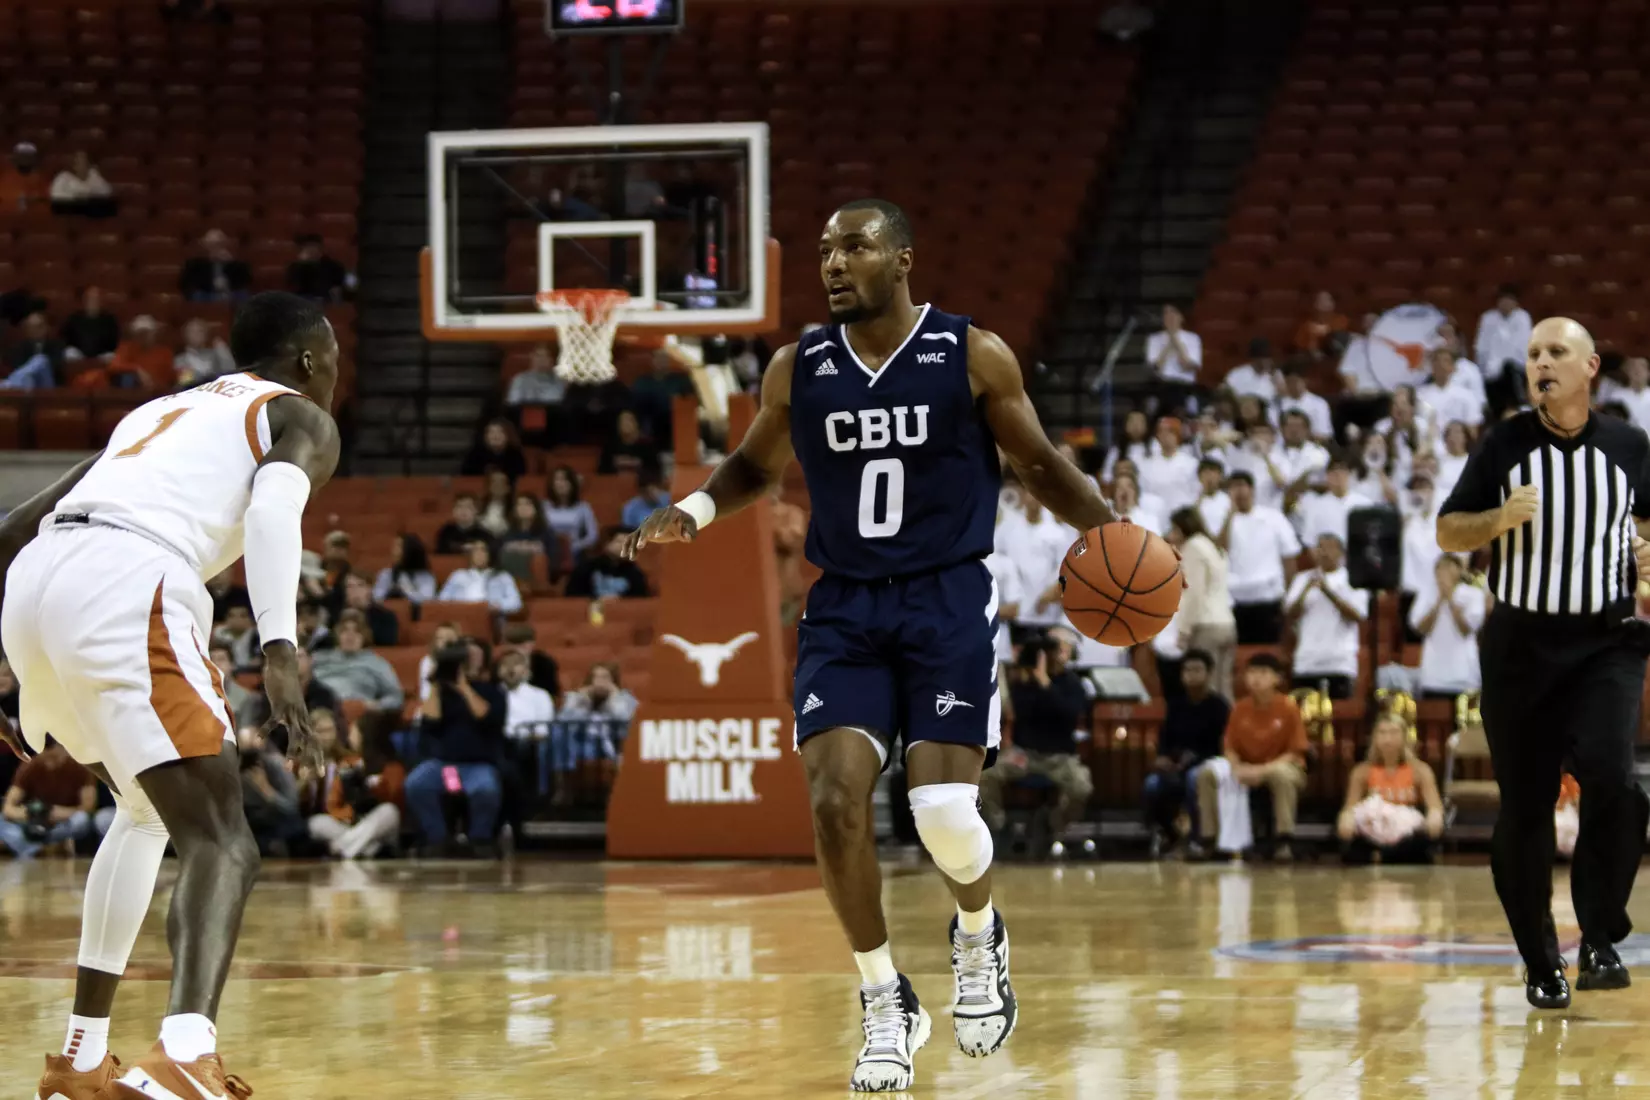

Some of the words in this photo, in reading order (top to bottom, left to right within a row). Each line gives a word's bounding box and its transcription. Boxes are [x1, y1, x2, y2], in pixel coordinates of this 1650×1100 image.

[815, 366, 839, 376] adidas
[916, 352, 947, 364] WAC
[112, 407, 194, 459] 1
[825, 404, 930, 452] CBU
[858, 458, 905, 538] 0
[801, 700, 824, 715] adidas
[639, 718, 782, 760] MUSCLE
[666, 761, 756, 804] MILK
